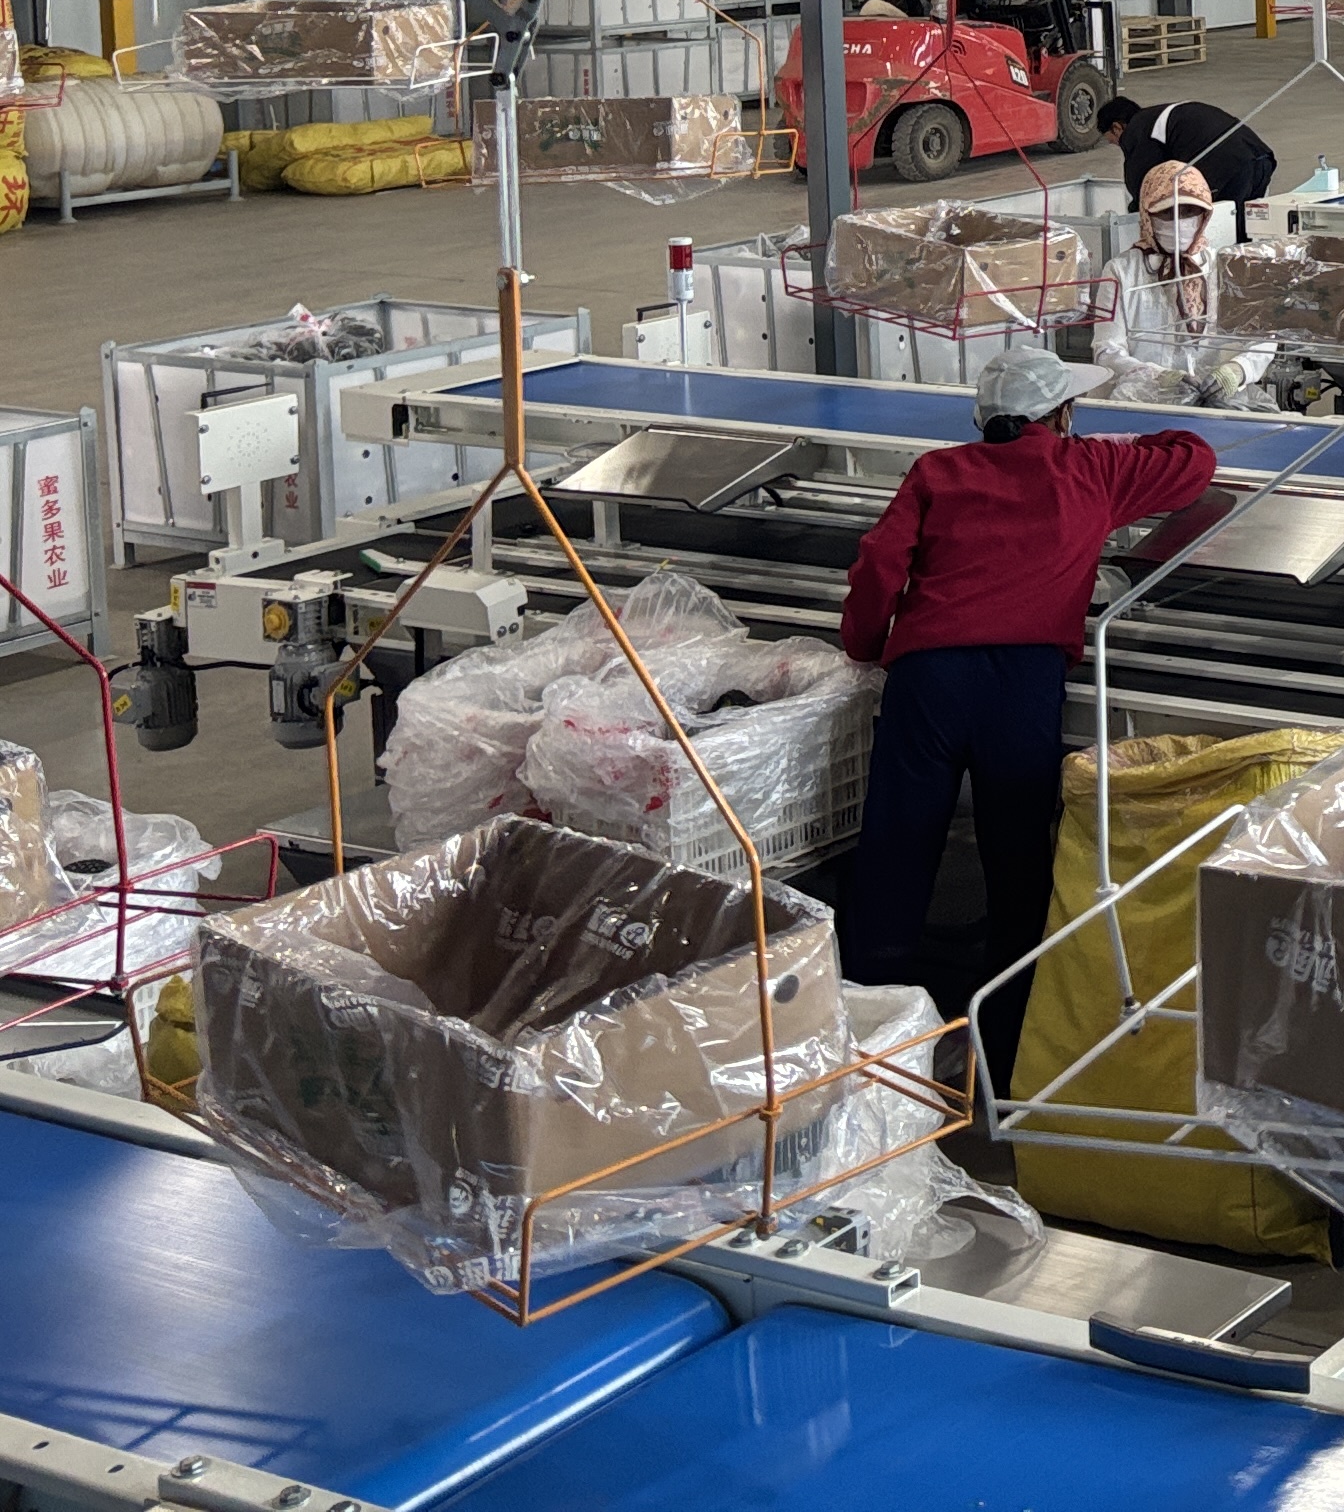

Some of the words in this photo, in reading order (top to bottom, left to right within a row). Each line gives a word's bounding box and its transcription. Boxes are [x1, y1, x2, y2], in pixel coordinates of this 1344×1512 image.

[37, 474, 69, 590] 蜜多果农业
